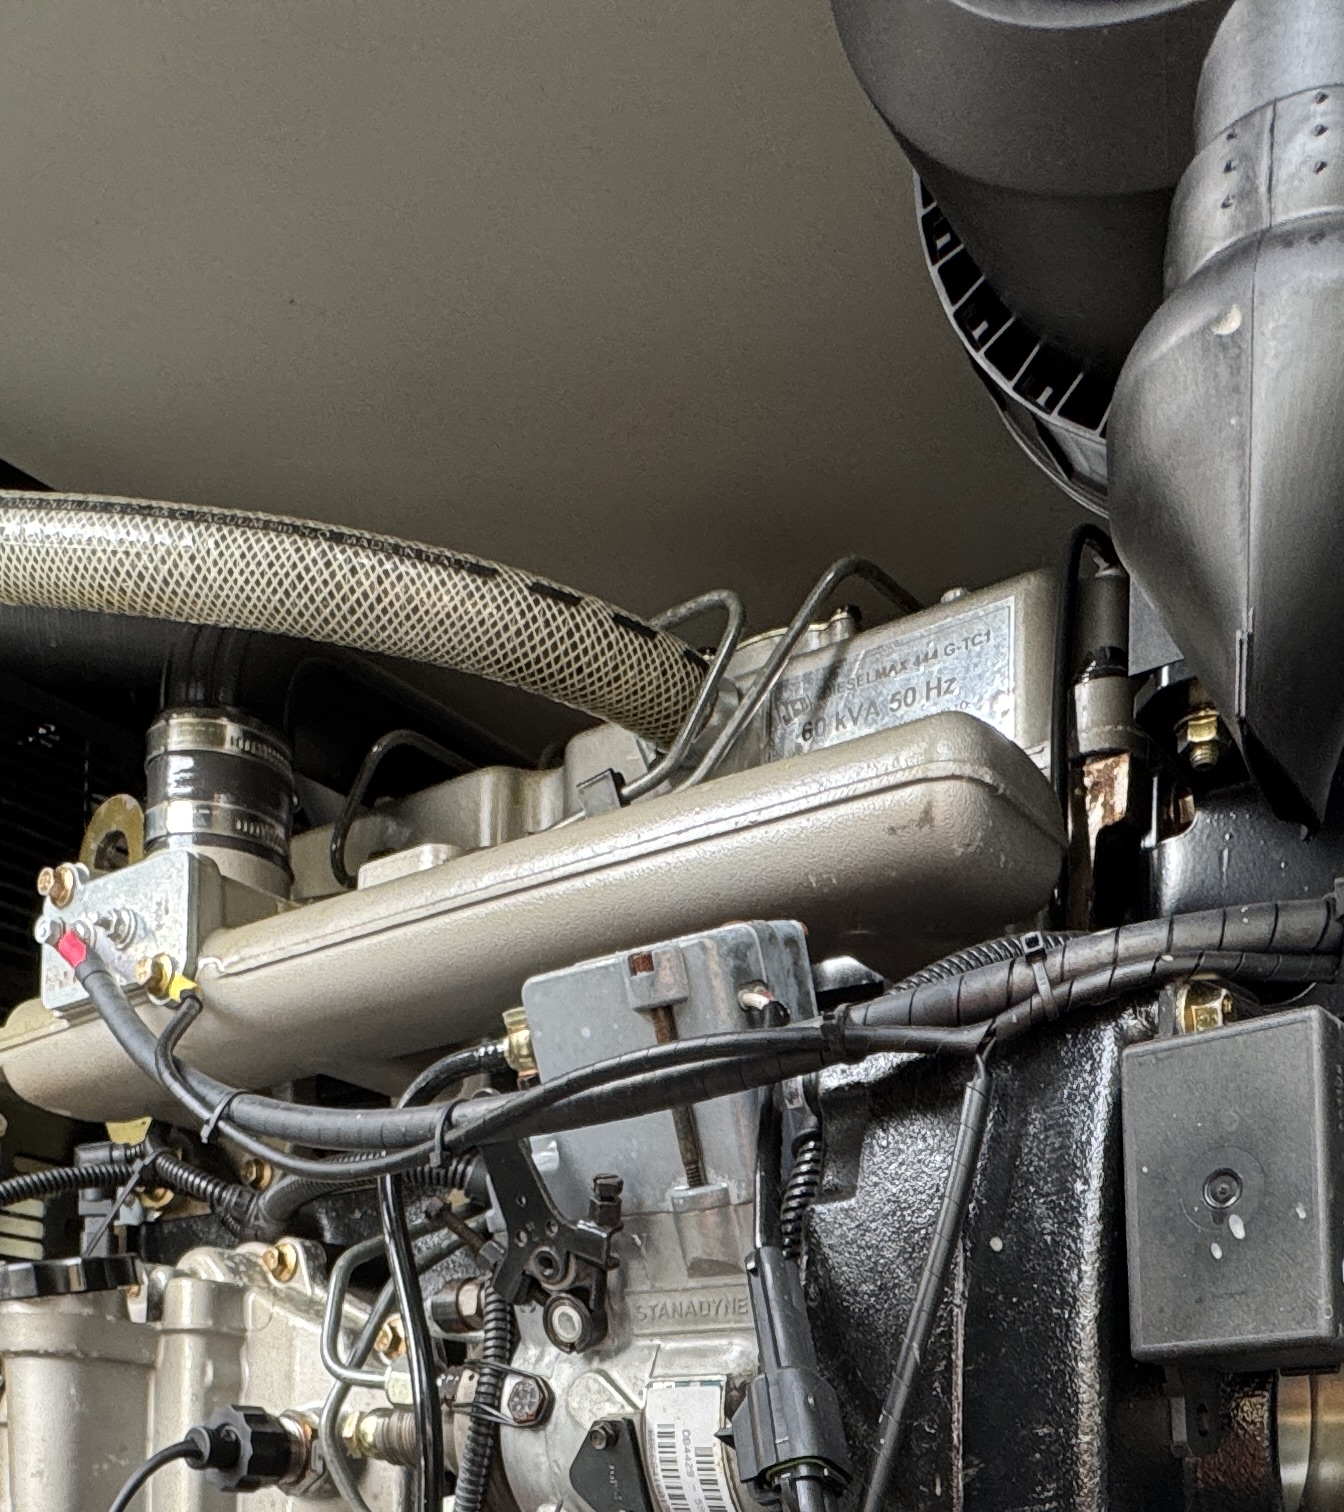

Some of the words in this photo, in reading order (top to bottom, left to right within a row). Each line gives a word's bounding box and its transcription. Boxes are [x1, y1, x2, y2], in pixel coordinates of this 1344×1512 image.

[194, 511, 264, 529] VACUUM
[342, 533, 394, 553] MADE
[399, 547, 417, 558] IN
[421, 551, 471, 570] ITALY
[944, 629, 991, 657] G-TC1
[835, 700, 880, 732] kVA
[889, 686, 917, 713] 50
[925, 676, 957, 702] Hz
[636, 1297, 749, 1321] STANADYNE
